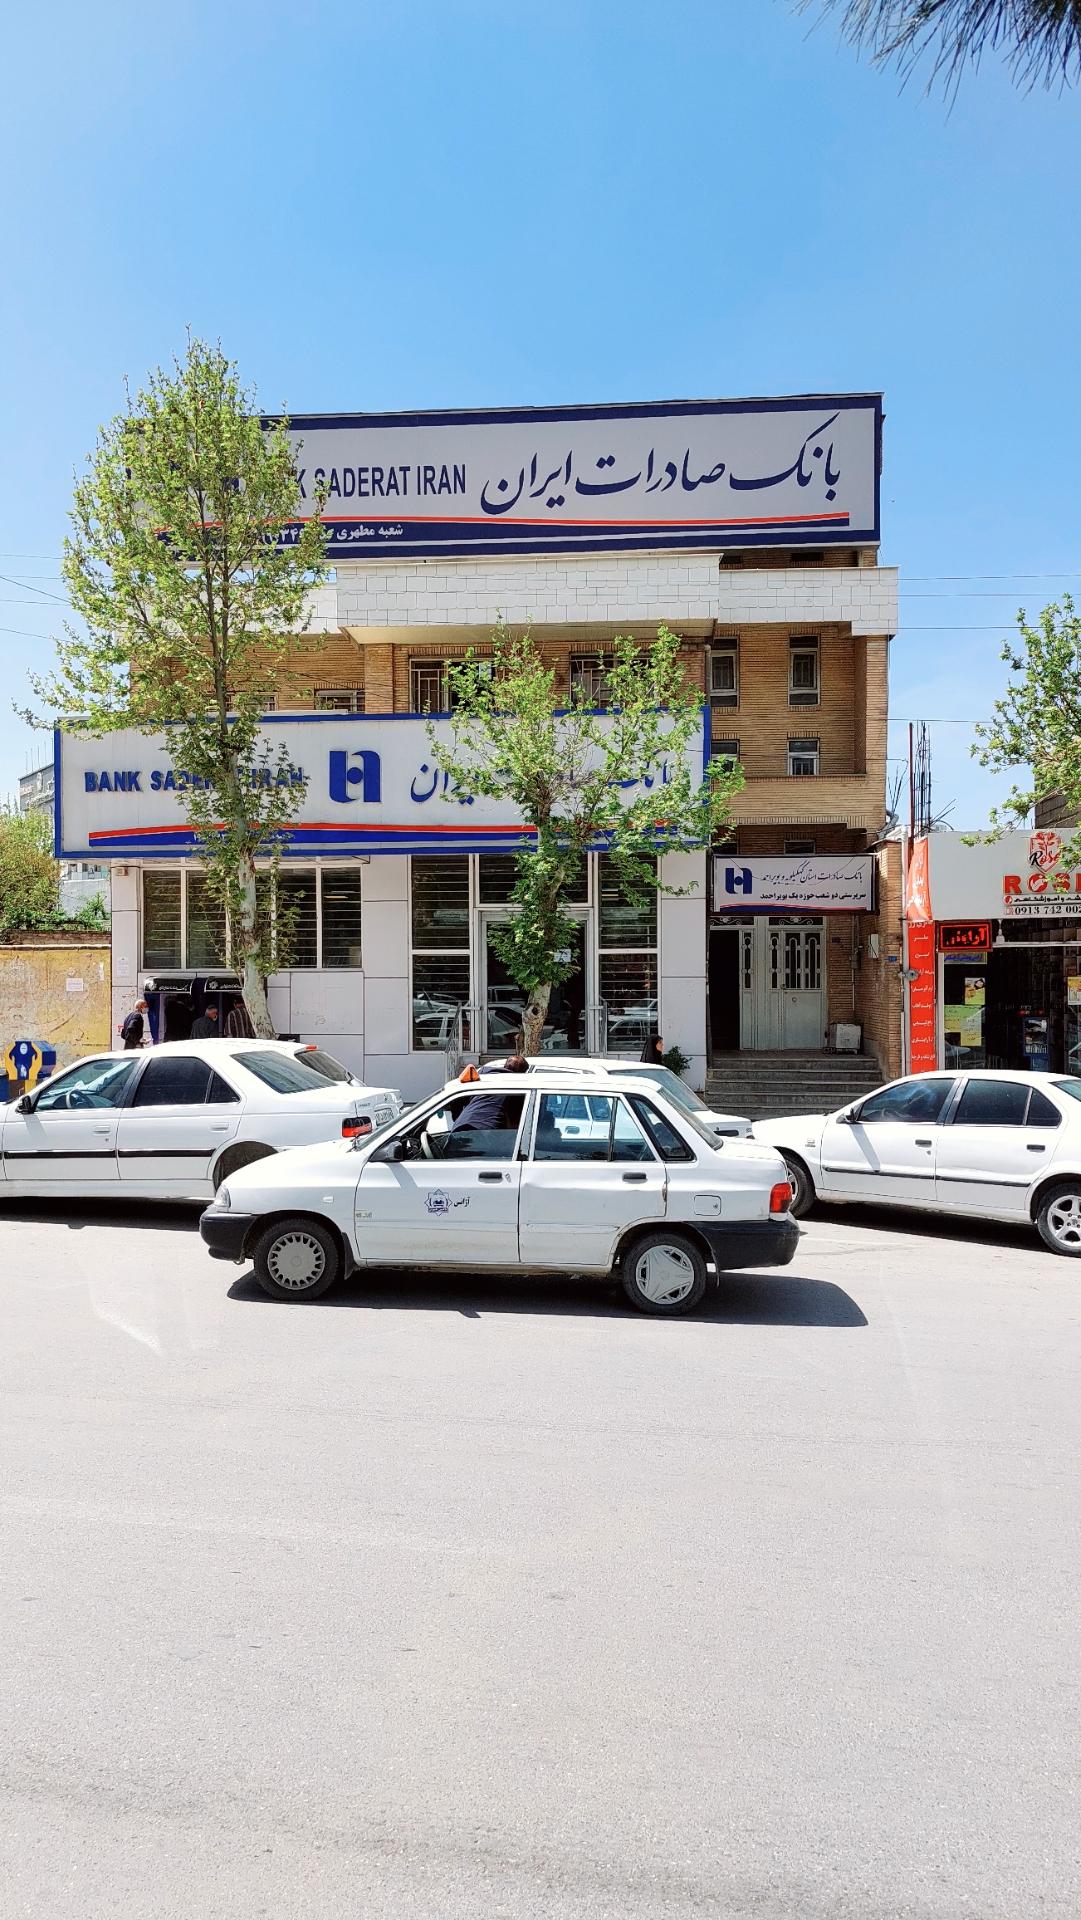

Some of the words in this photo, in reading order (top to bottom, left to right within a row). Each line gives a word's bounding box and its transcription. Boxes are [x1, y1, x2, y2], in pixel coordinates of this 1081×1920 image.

[729, 411, 841, 502] بانک
[416, 463, 466, 496] IRAN
[480, 449, 573, 515] ایران
[575, 447, 726, 496] صادرات
[336, 524, 375, 541] مطهری
[378, 524, 404, 539] شعبه
[84, 770, 141, 793] BANK
[844, 863, 867, 883] بانک
